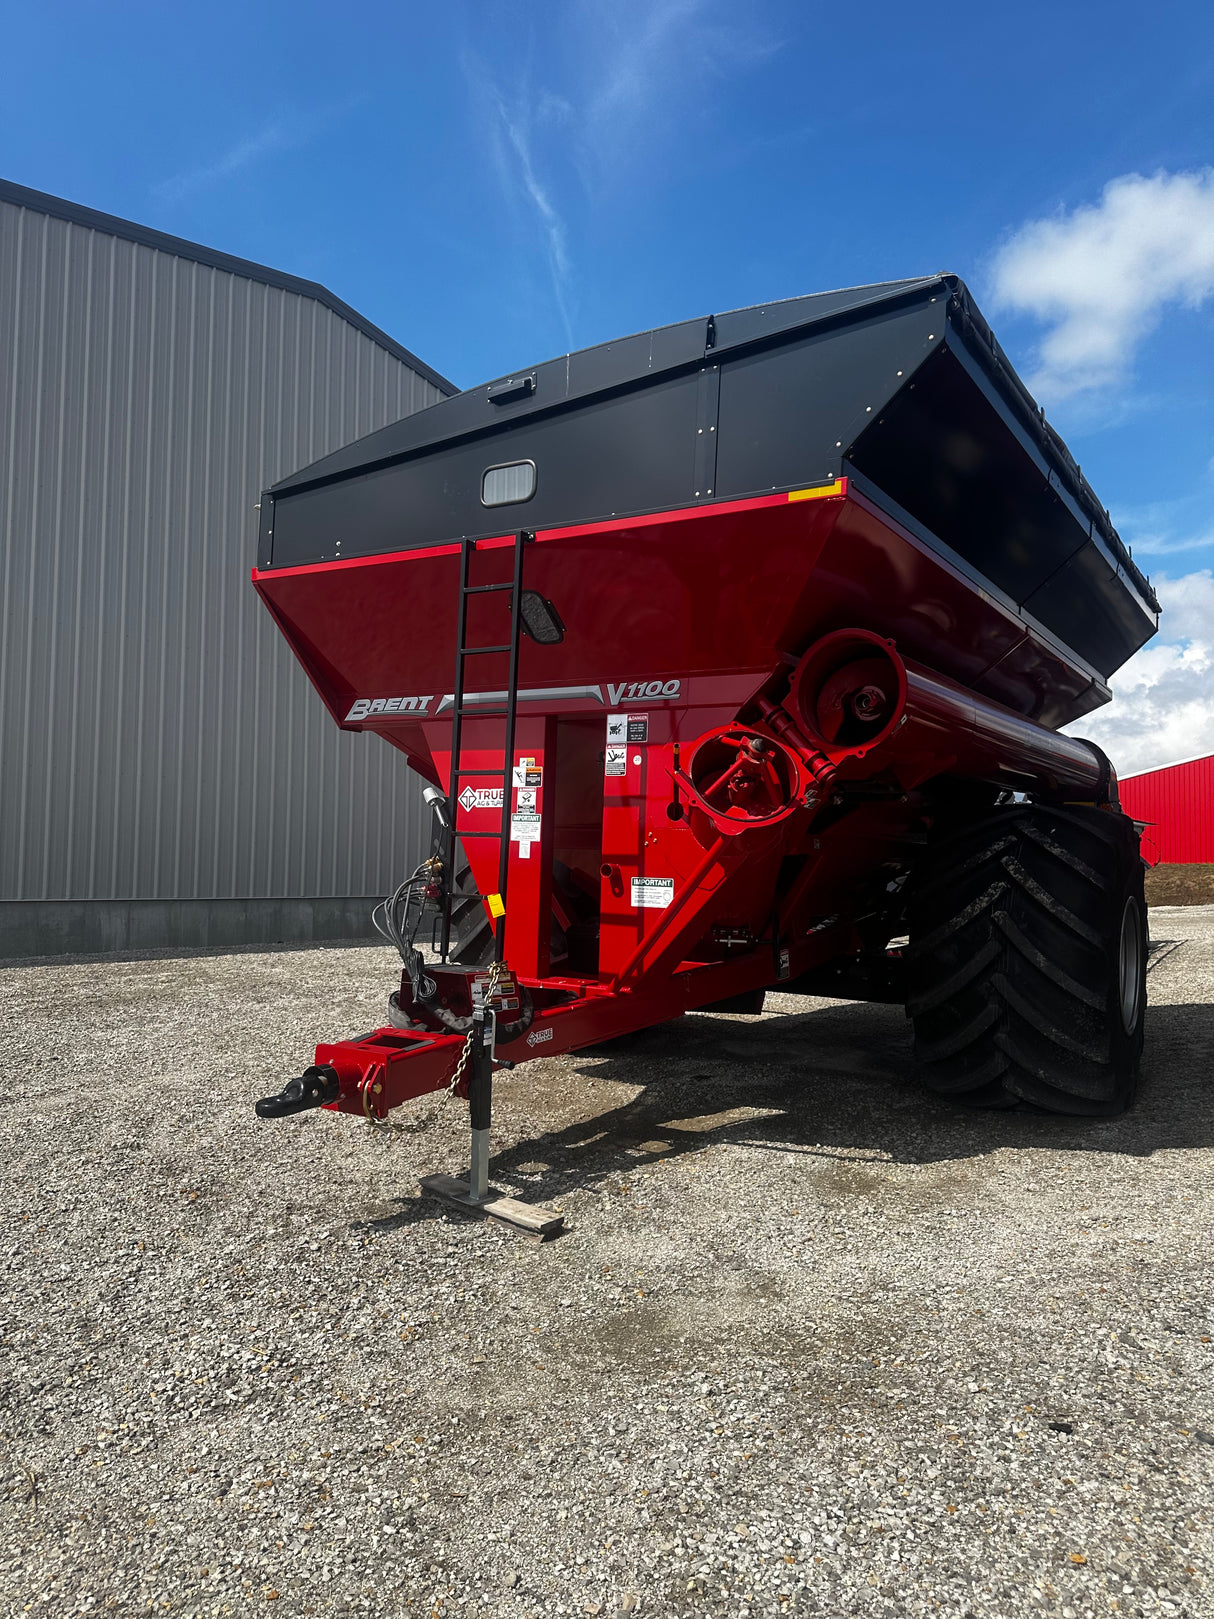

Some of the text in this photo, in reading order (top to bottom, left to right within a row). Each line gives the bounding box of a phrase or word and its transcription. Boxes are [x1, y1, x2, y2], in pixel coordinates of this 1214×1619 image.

[606, 680, 681, 706] V1100
[344, 695, 434, 721] BRENT
[477, 790, 504, 799] TRUE
[634, 878, 671, 886] IMPORTANT
[536, 1028, 552, 1038] TRUE
